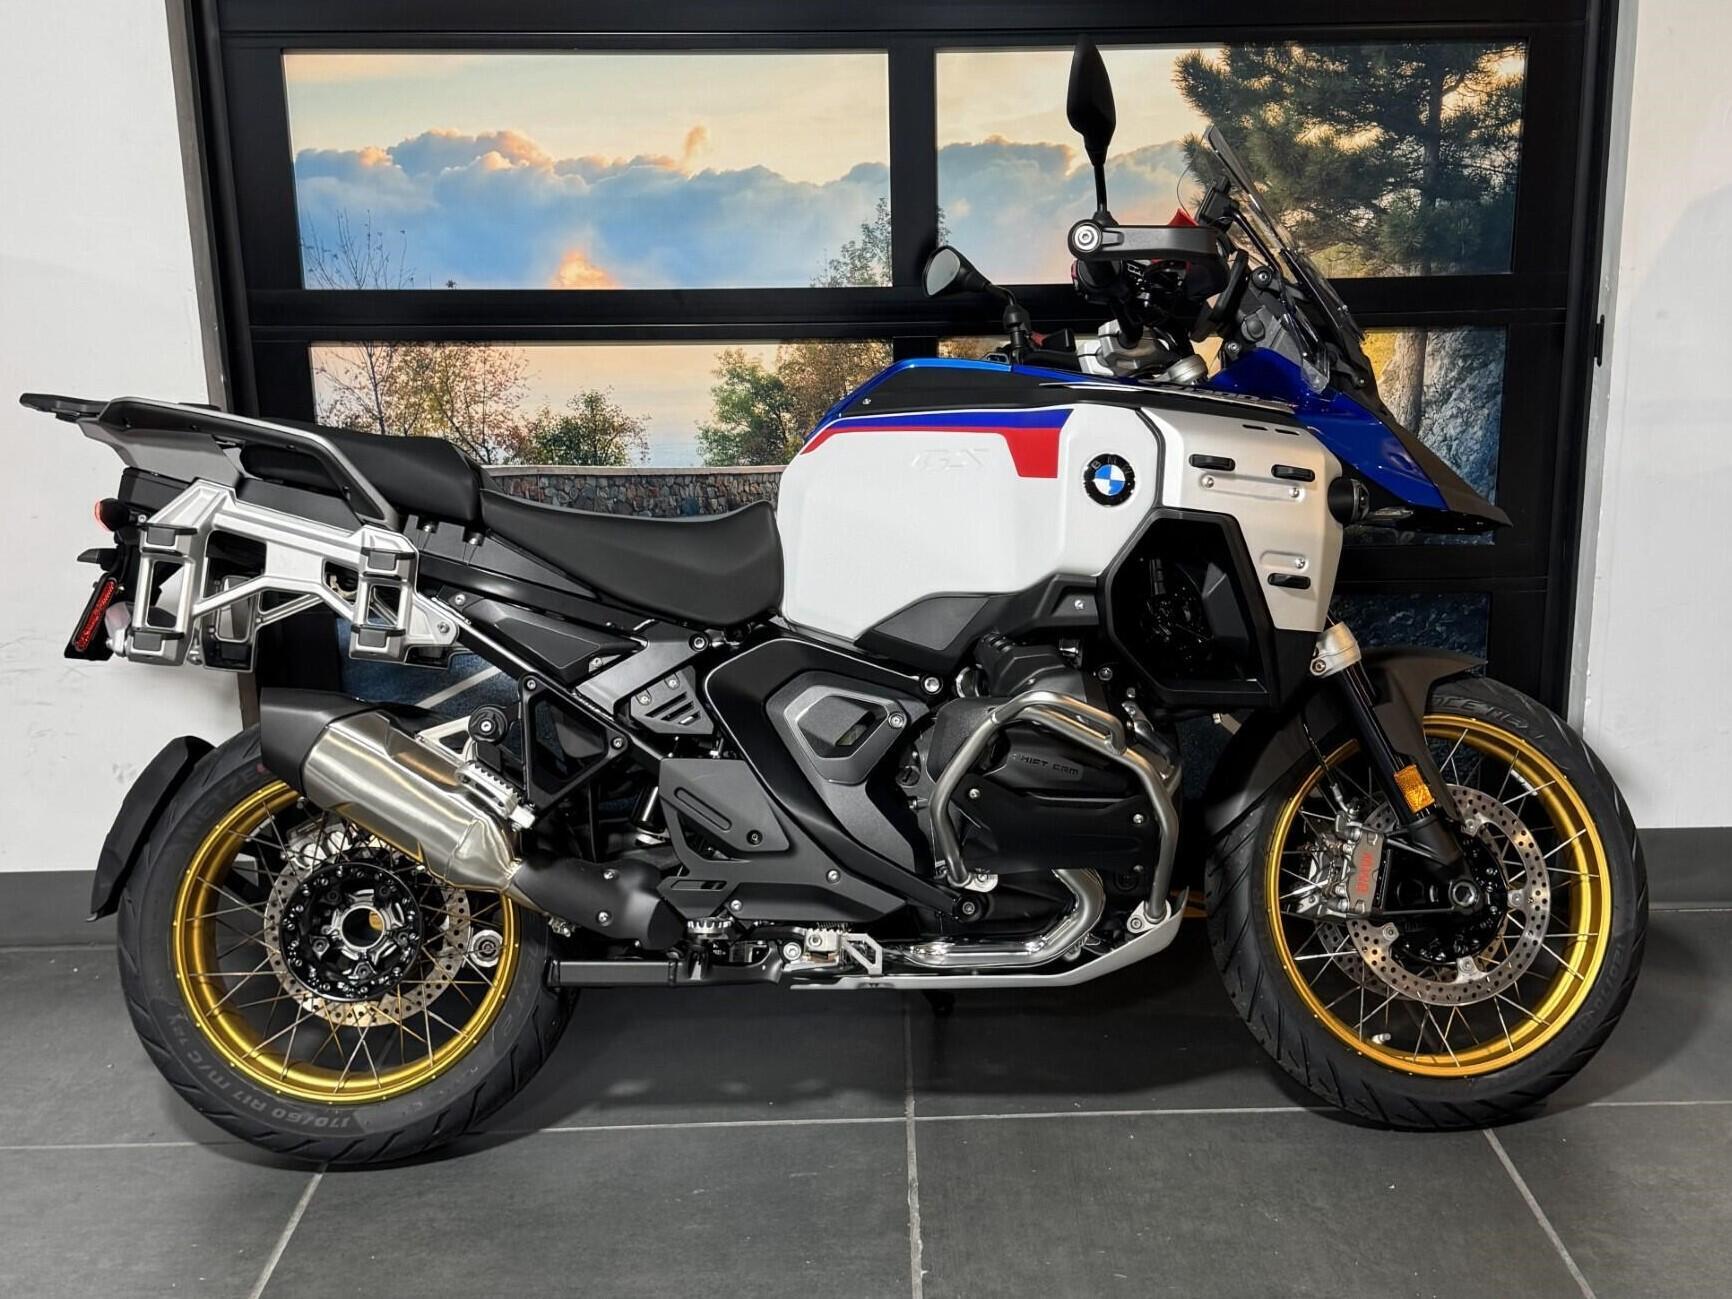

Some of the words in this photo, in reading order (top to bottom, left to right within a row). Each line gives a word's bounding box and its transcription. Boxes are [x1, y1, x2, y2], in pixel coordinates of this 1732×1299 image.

[1356, 852, 1373, 892] BMW
[233, 1091, 266, 1112] R17
[272, 1107, 351, 1128] 170/60
